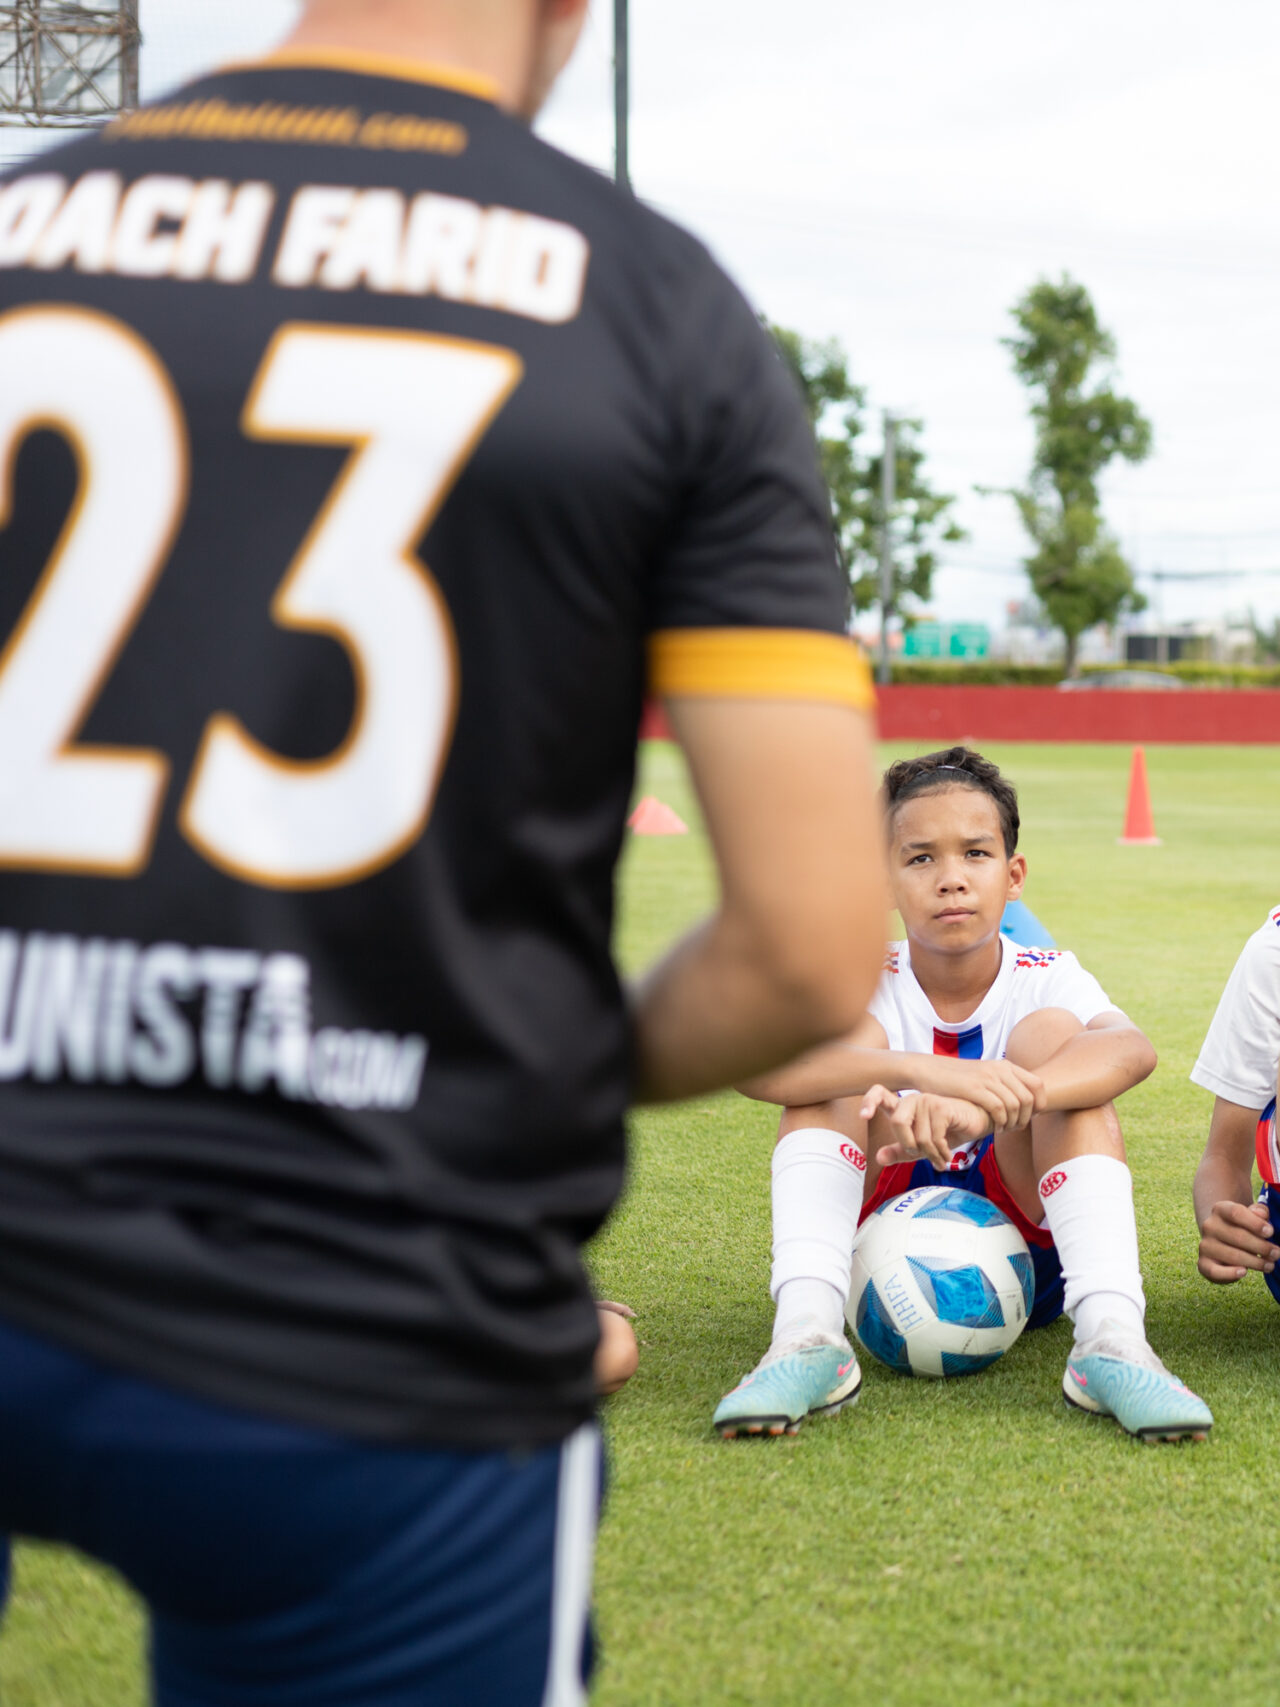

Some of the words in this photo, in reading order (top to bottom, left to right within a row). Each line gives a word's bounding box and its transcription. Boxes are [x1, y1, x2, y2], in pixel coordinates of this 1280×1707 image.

[272, 183, 590, 325] FARID
[0, 303, 524, 893] 23
[884, 1273, 923, 1331] HHFA
